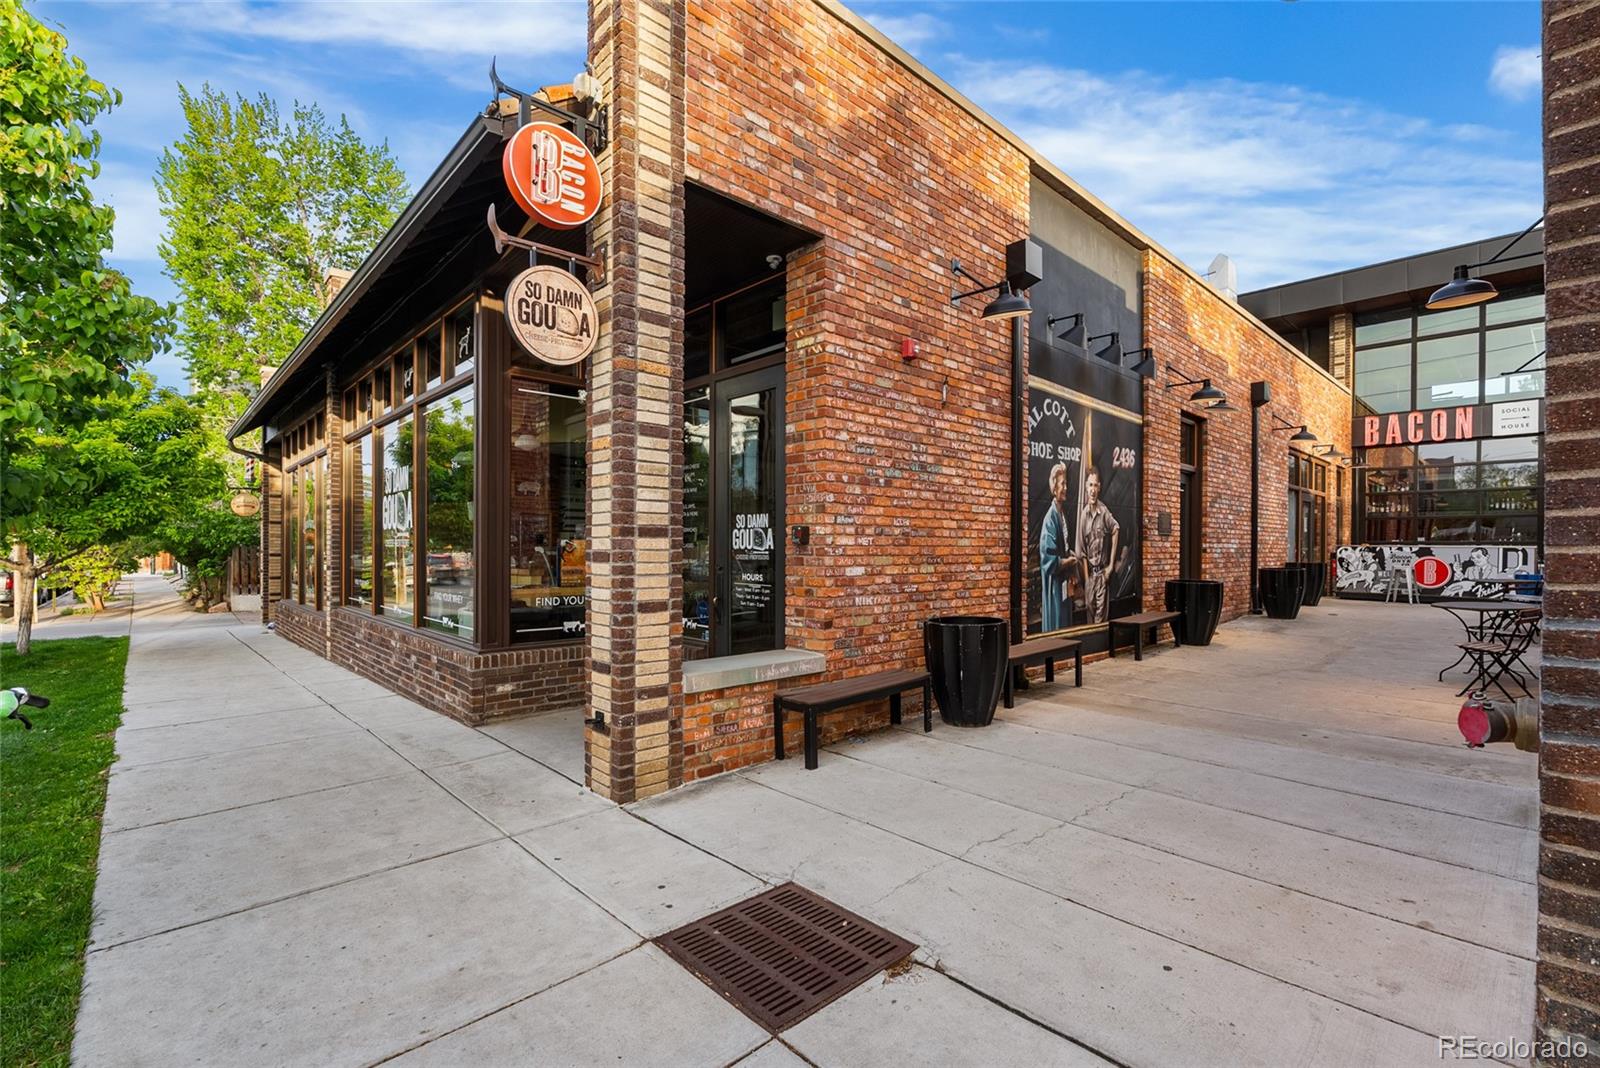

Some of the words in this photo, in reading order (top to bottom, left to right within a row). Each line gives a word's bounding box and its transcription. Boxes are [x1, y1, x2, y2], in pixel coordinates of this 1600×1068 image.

[560, 140, 586, 215] BACON
[524, 280, 542, 300] SO
[546, 286, 583, 310] DAMN
[517, 297, 591, 338] GOUDA
[1501, 406, 1530, 414] SOCIAL
[1364, 405, 1474, 447] BACON
[1057, 446, 1082, 462] SHOP
[1112, 446, 1136, 468] 2436
[735, 513, 746, 529] SO
[747, 512, 769, 528] DAMN
[732, 527, 774, 551] GOUDA
[741, 573, 764, 582] HOURS
[1423, 559, 1437, 585] B
[1471, 582, 1504, 599] Fresh
[535, 597, 561, 607] FIND
